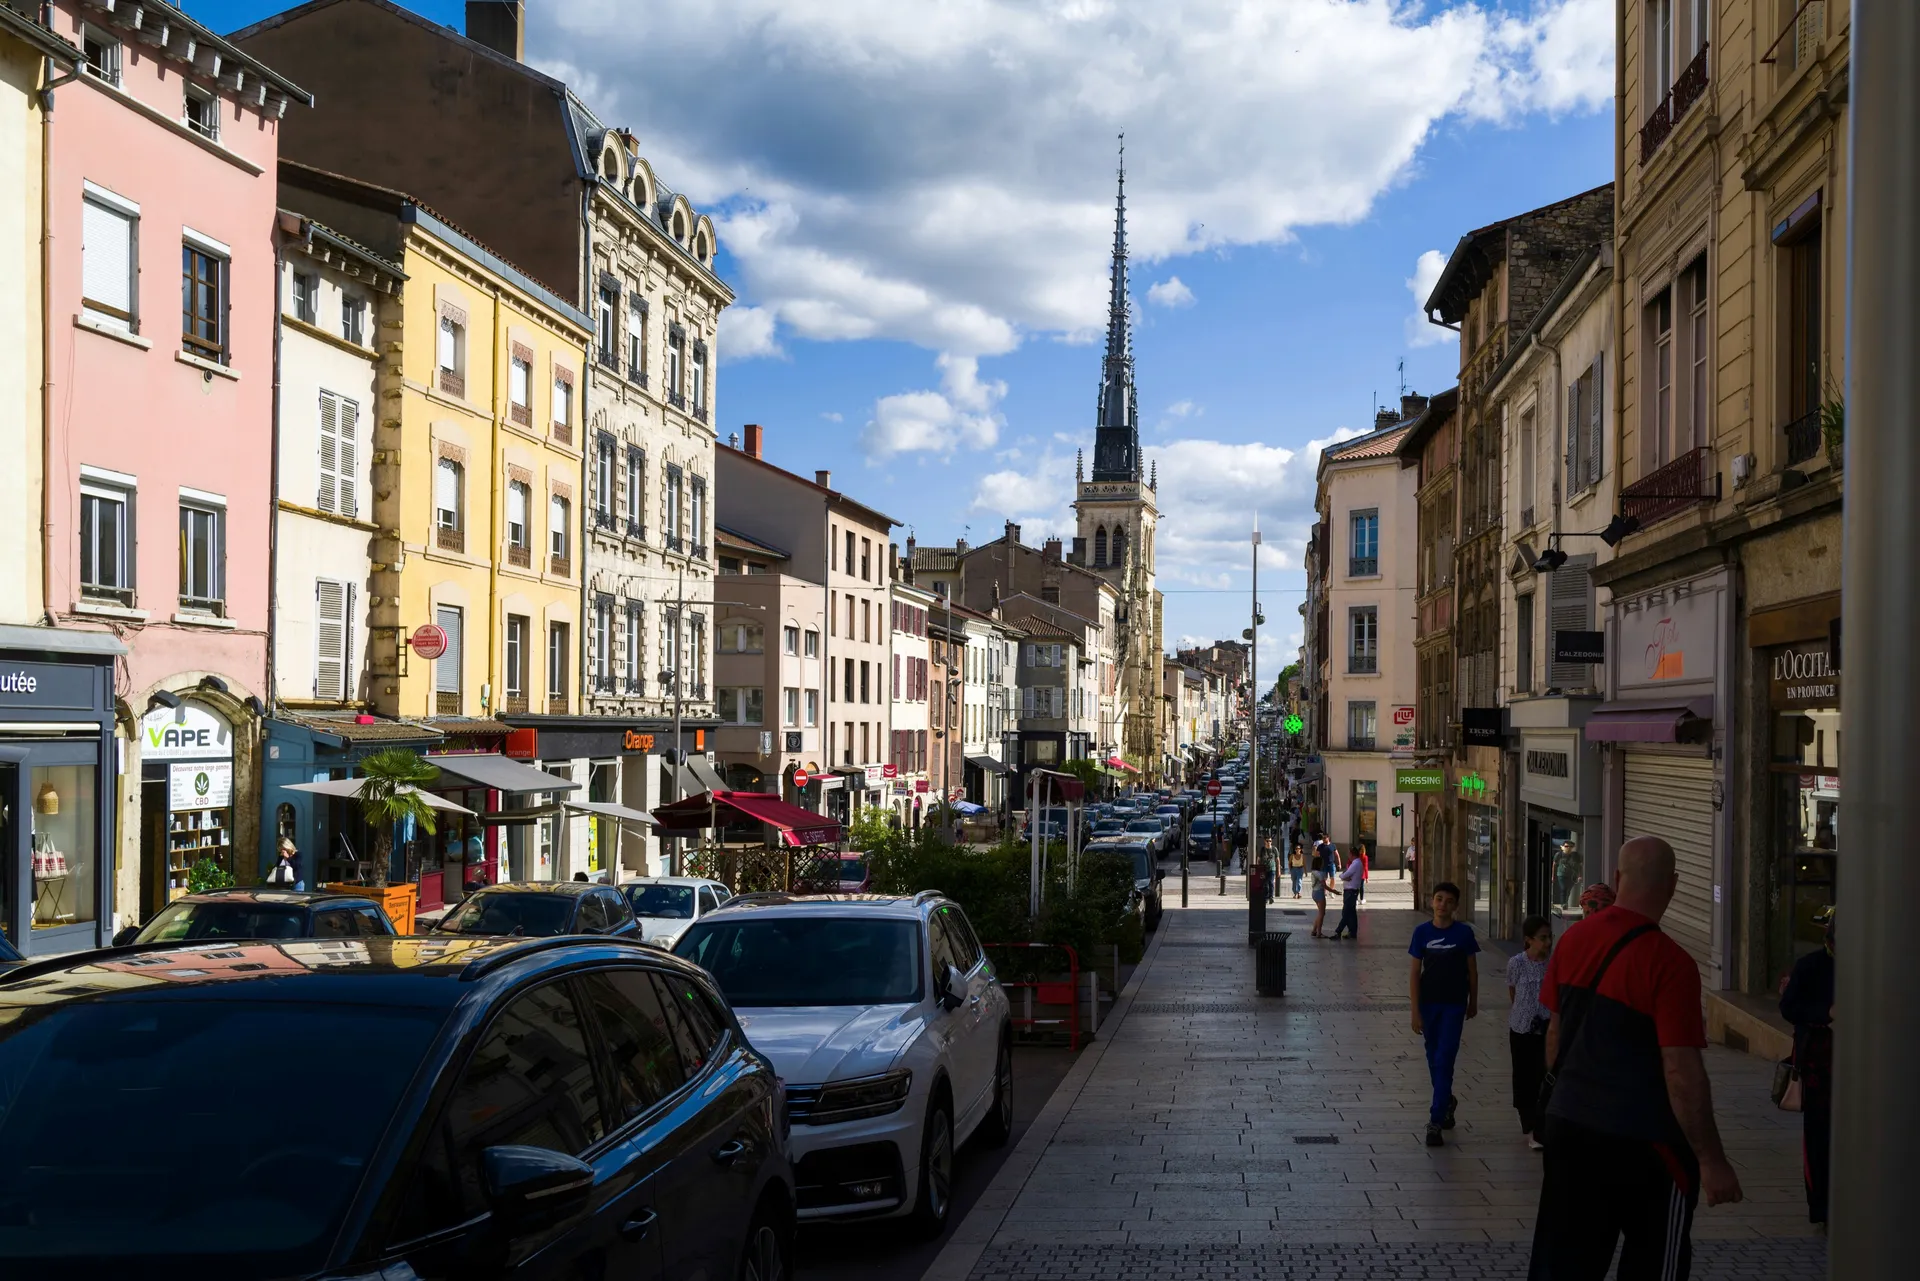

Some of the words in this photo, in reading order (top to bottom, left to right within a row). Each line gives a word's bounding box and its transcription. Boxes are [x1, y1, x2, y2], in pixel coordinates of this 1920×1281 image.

[1774, 650, 1842, 680] L'OCCITA
[1787, 687, 1797, 699] EN
[1797, 684, 1835, 698] PROVENCE
[148, 727, 210, 748] VAPE
[625, 730, 654, 752] Orange
[1527, 750, 1568, 778] CALZEDONIA
[1399, 776, 1441, 785] PRESSING
[195, 797, 209, 805] CBD
